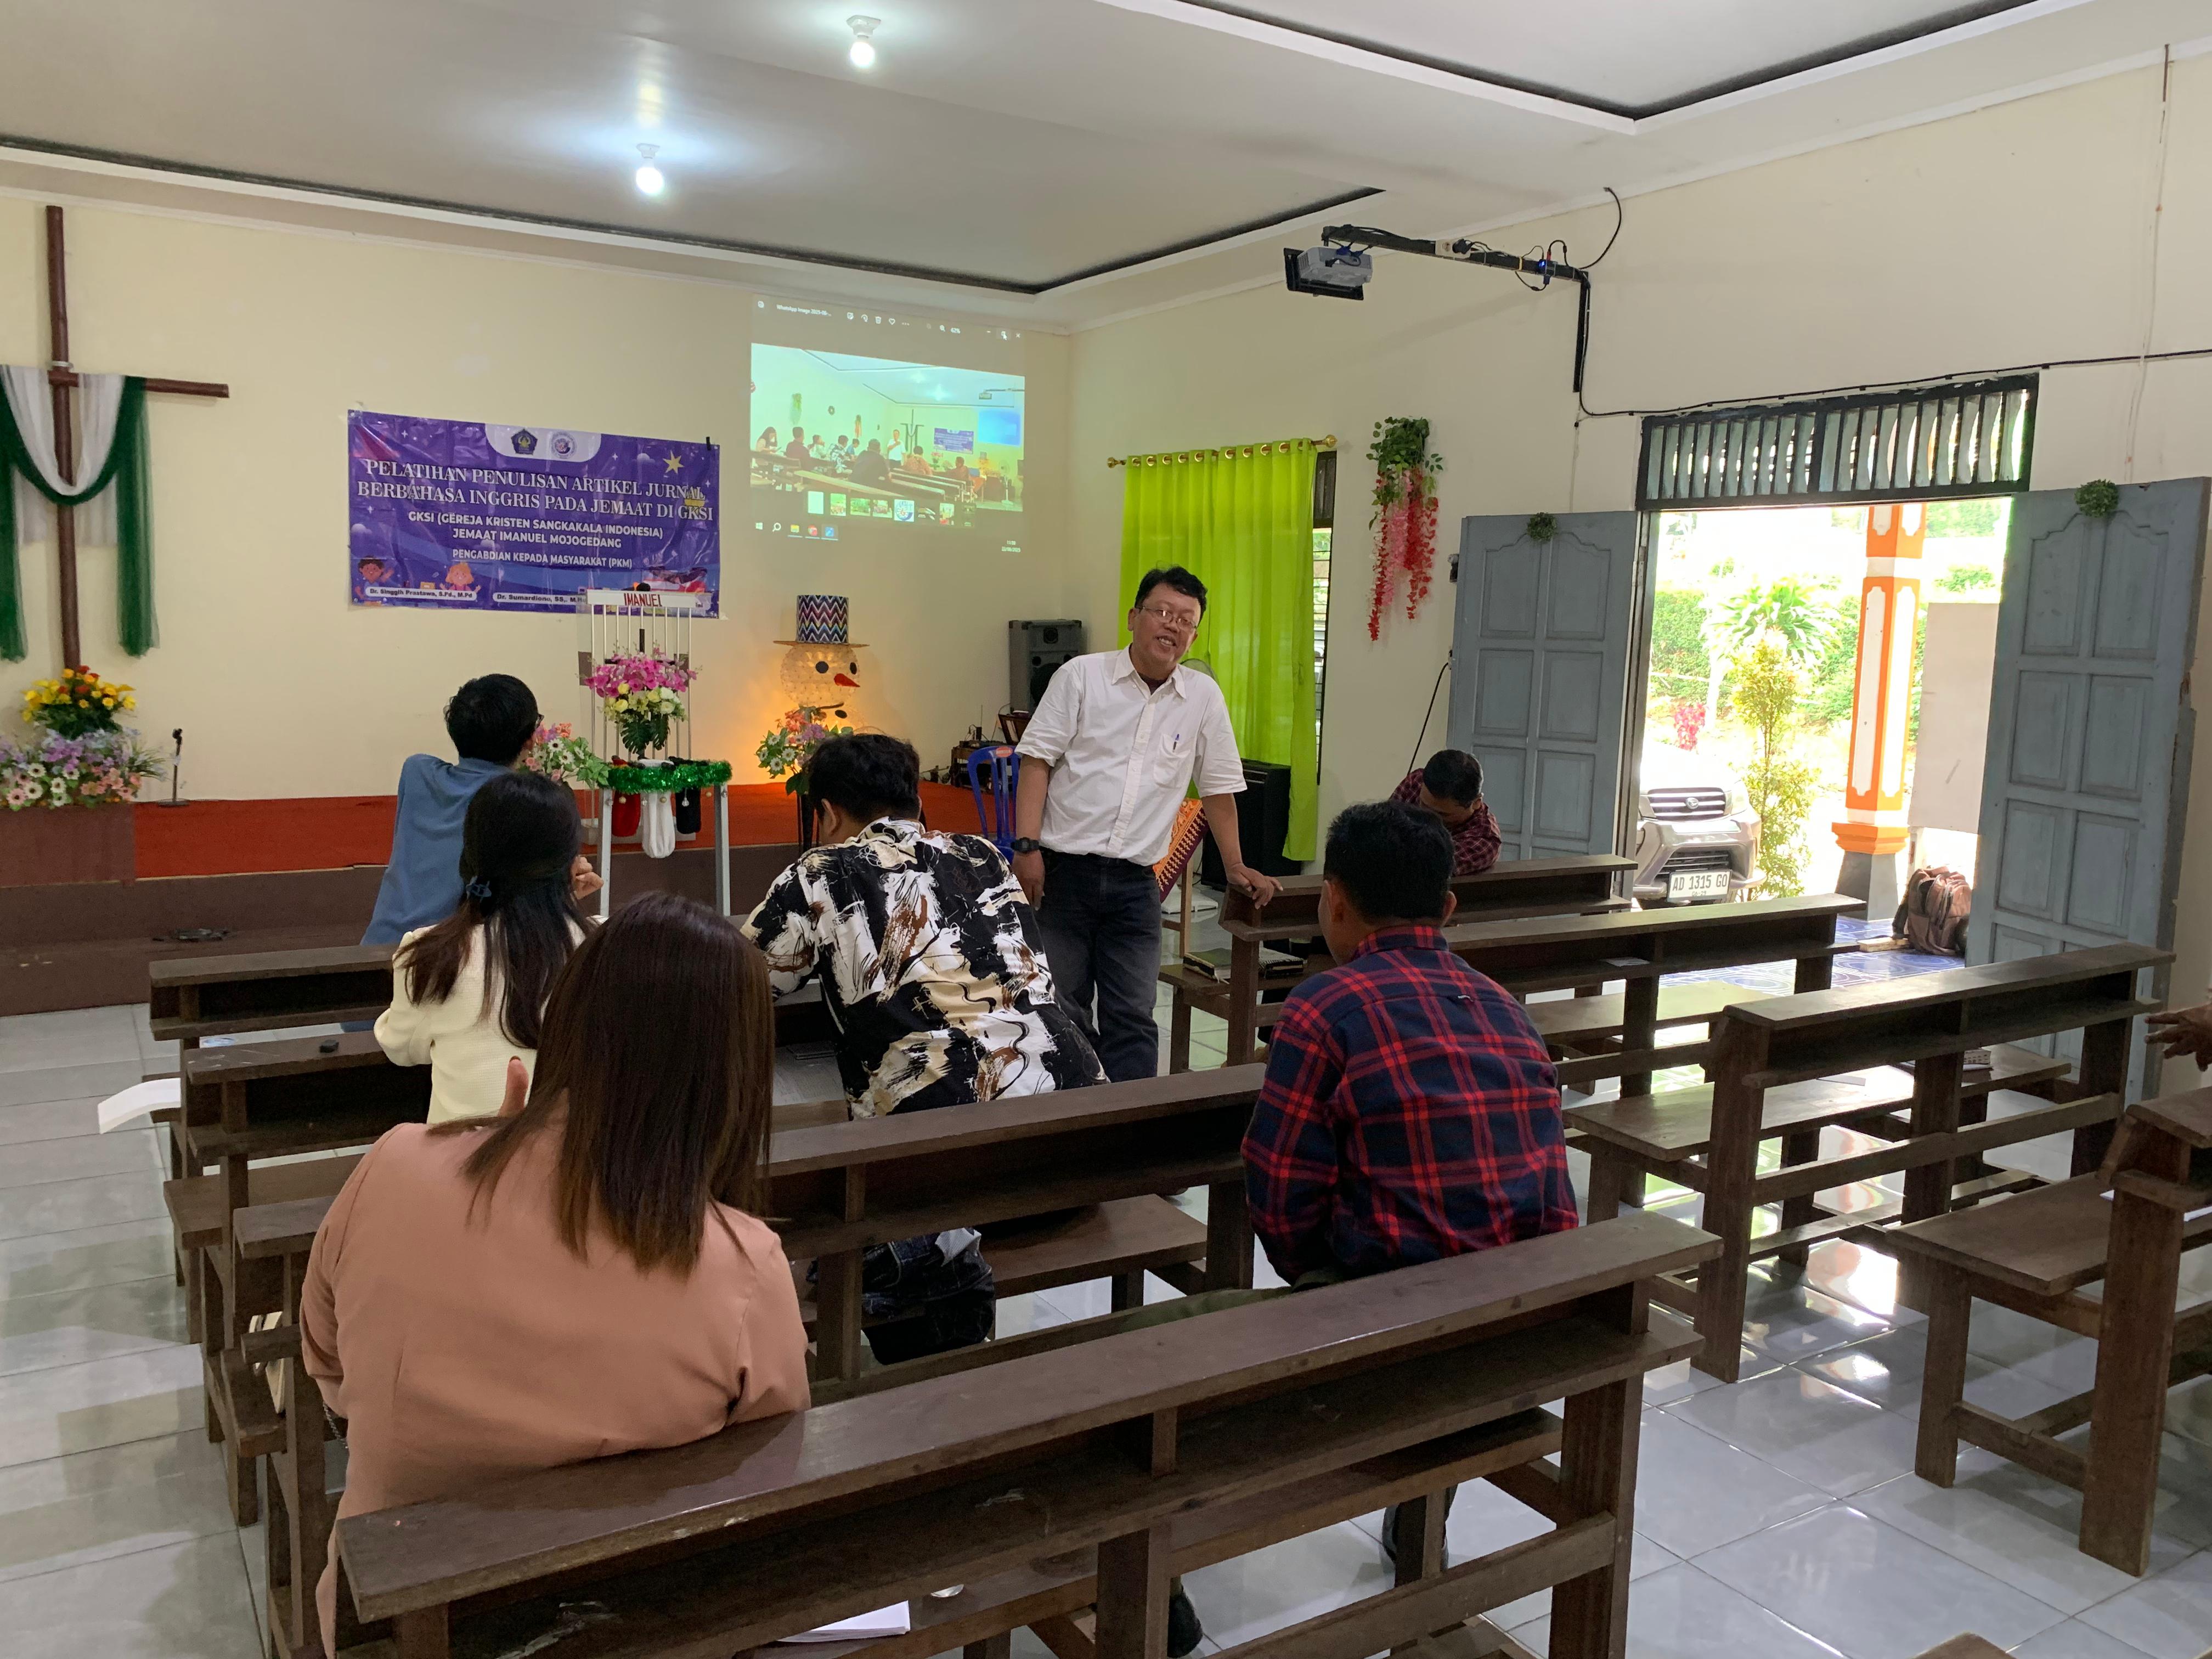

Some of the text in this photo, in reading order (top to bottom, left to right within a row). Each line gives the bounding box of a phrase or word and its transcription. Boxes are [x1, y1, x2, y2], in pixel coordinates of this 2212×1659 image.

[366, 459, 706, 500] PELATIHAN PENULISAN ARTIKEL JURNAL
[357, 481, 713, 521] BERBAHASA INGGRIS PADA JEMAAT DI GKSI
[408, 511, 663, 539] GKSI (GEREJA KRISTEN SANGKAKALA INDONESIA)
[453, 528, 622, 548] JEMAAT IMANUEL MOJOGEDANG
[453, 549, 632, 569] PENGABDIAN KEPADA MASYARAKAT (PKM)
[509, 594, 552, 602] Sumardiono,
[1672, 874, 1728, 891] AD 1315 GO
